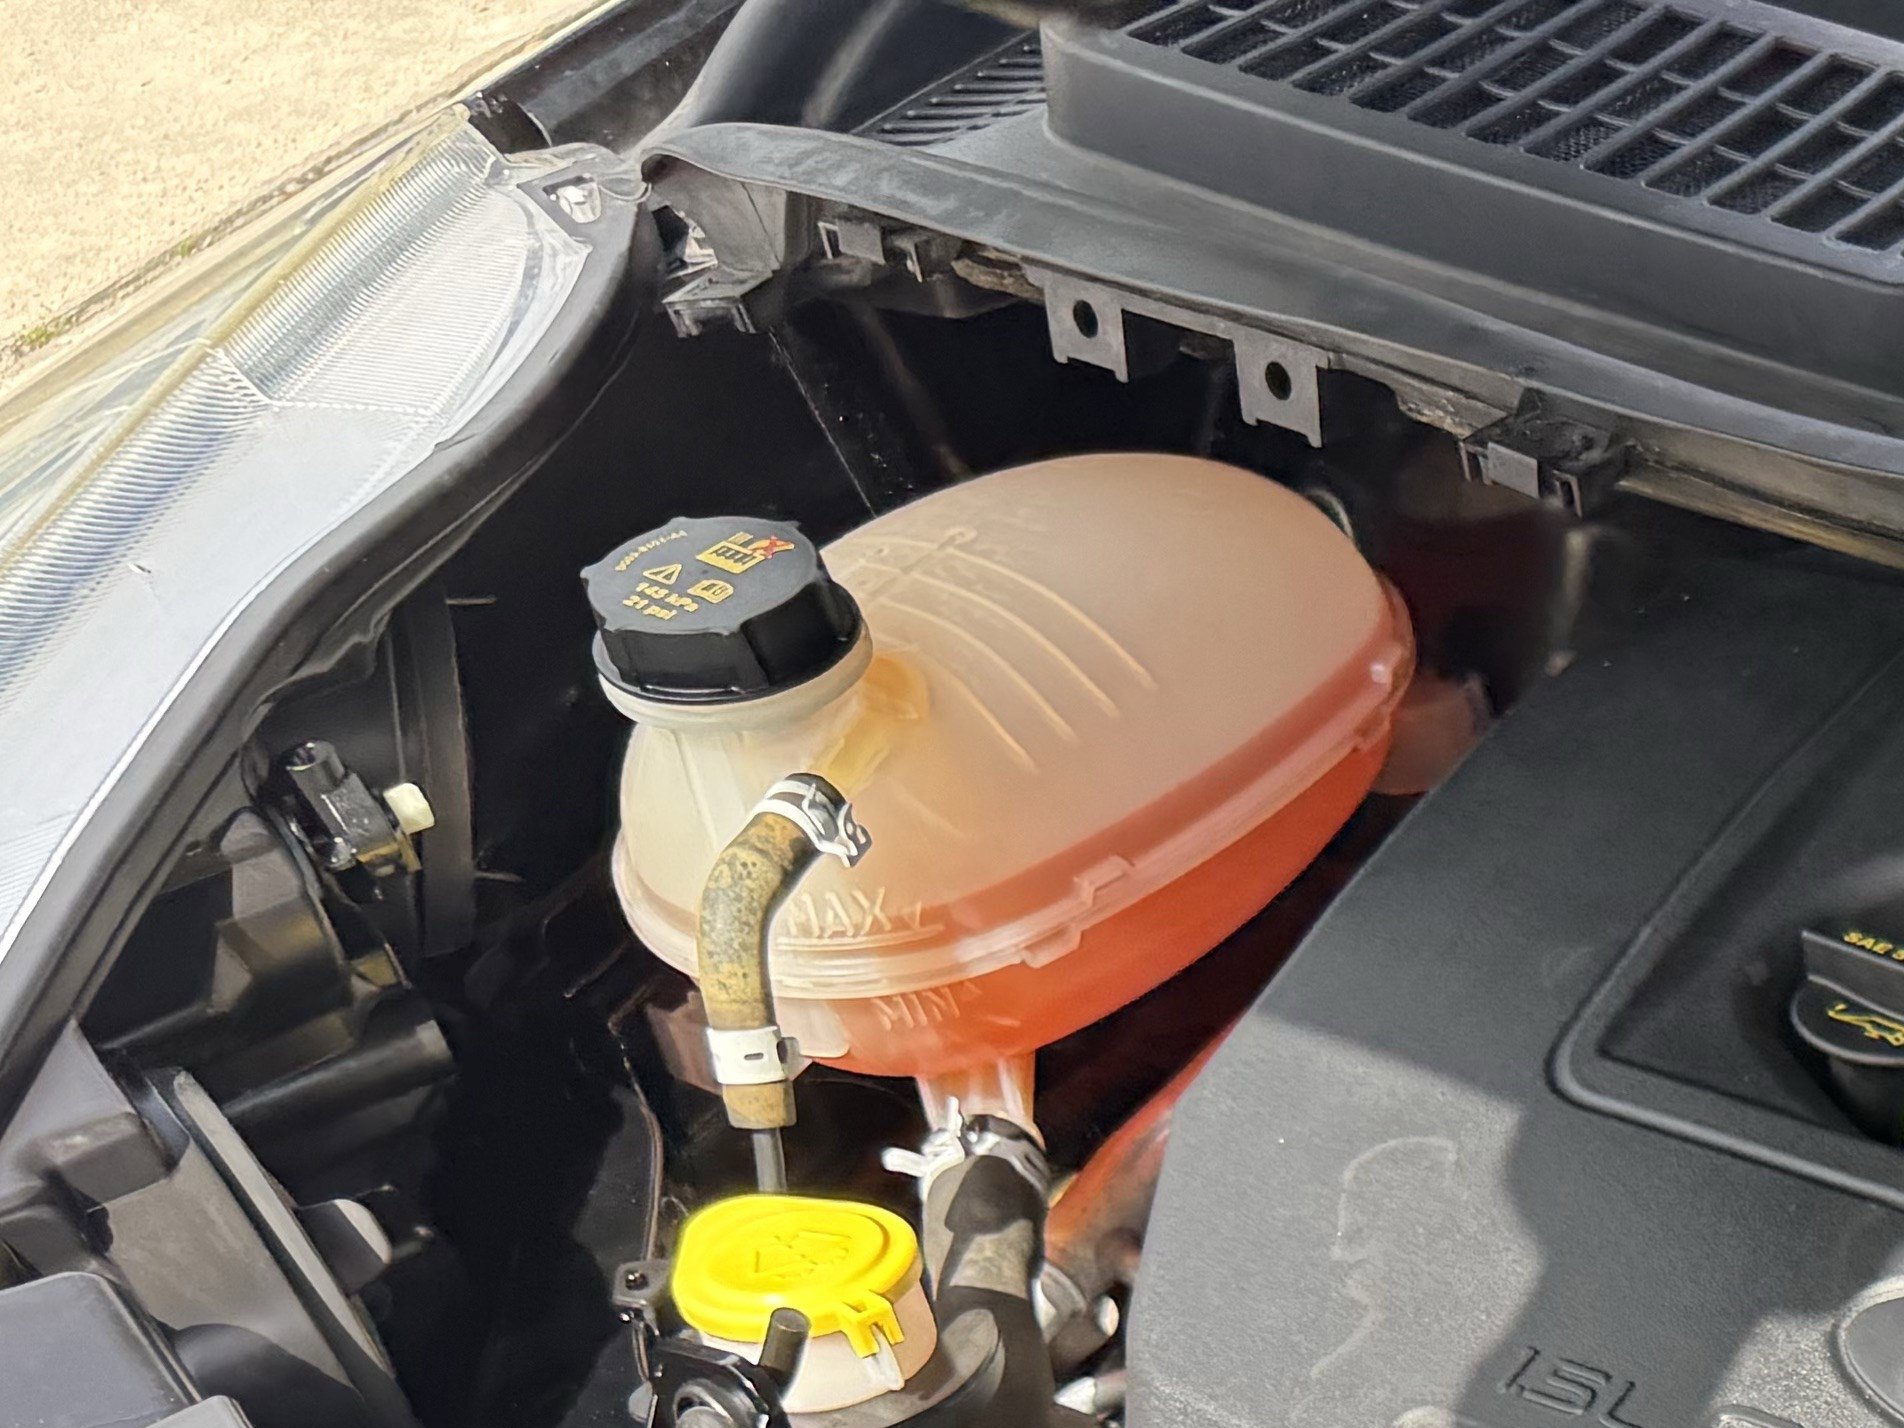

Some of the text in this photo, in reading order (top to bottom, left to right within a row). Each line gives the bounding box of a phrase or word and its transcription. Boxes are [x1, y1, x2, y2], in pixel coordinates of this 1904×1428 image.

[786, 886, 893, 938] MAX
[1843, 931, 1893, 955] SAE
[870, 984, 961, 1031] MIN
